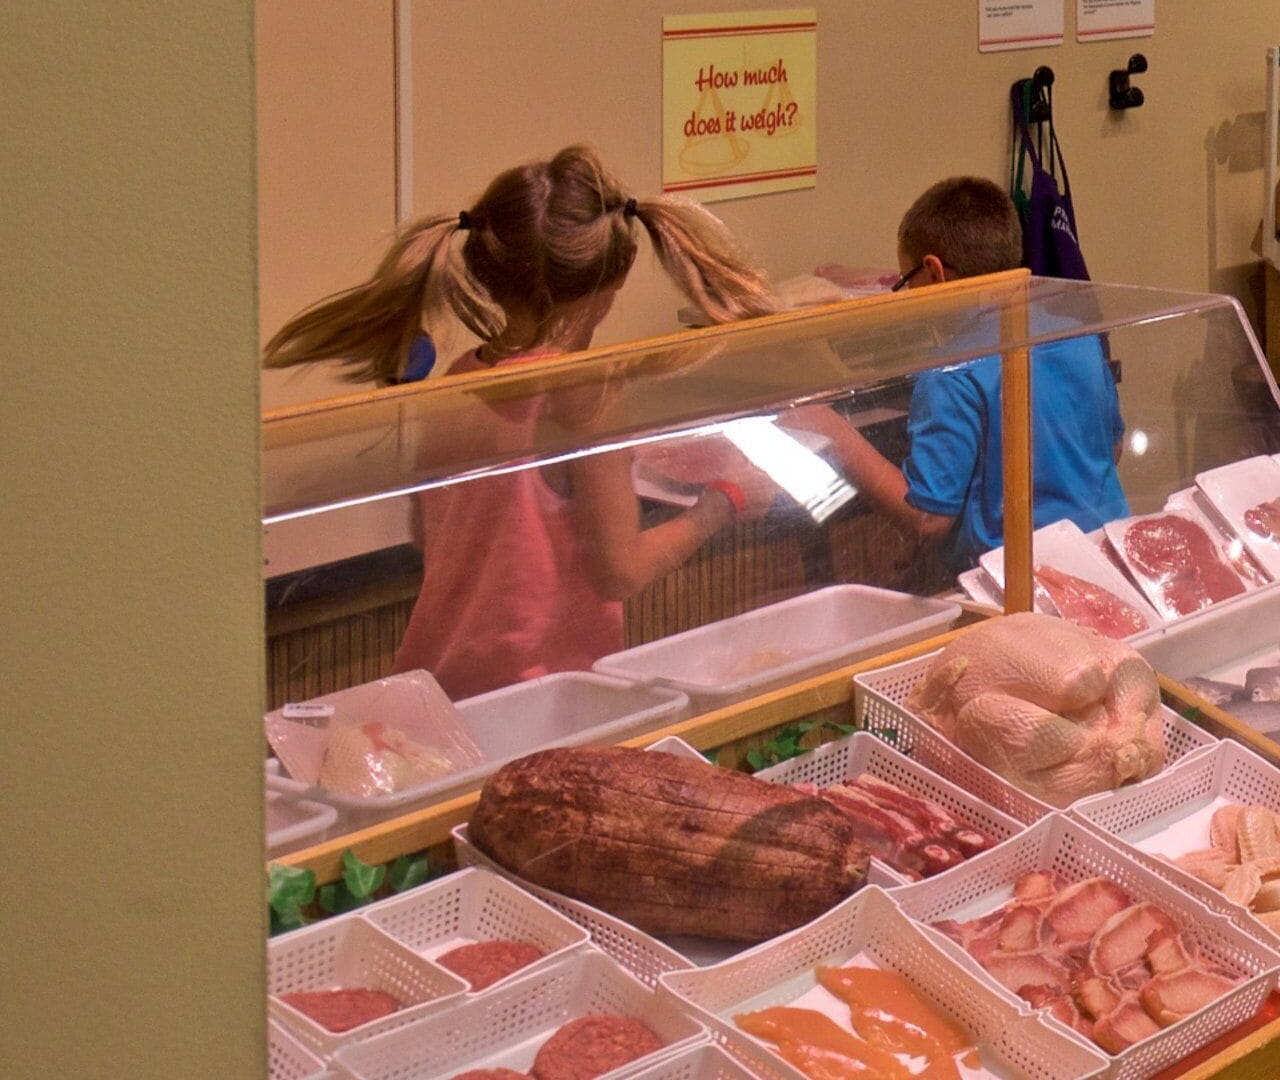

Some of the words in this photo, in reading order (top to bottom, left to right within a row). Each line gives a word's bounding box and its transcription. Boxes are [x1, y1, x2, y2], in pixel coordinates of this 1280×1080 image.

[694, 64, 739, 92] How
[743, 58, 788, 86] much
[683, 112, 722, 137] does
[725, 111, 736, 133] it
[740, 102, 798, 136] weigh?
